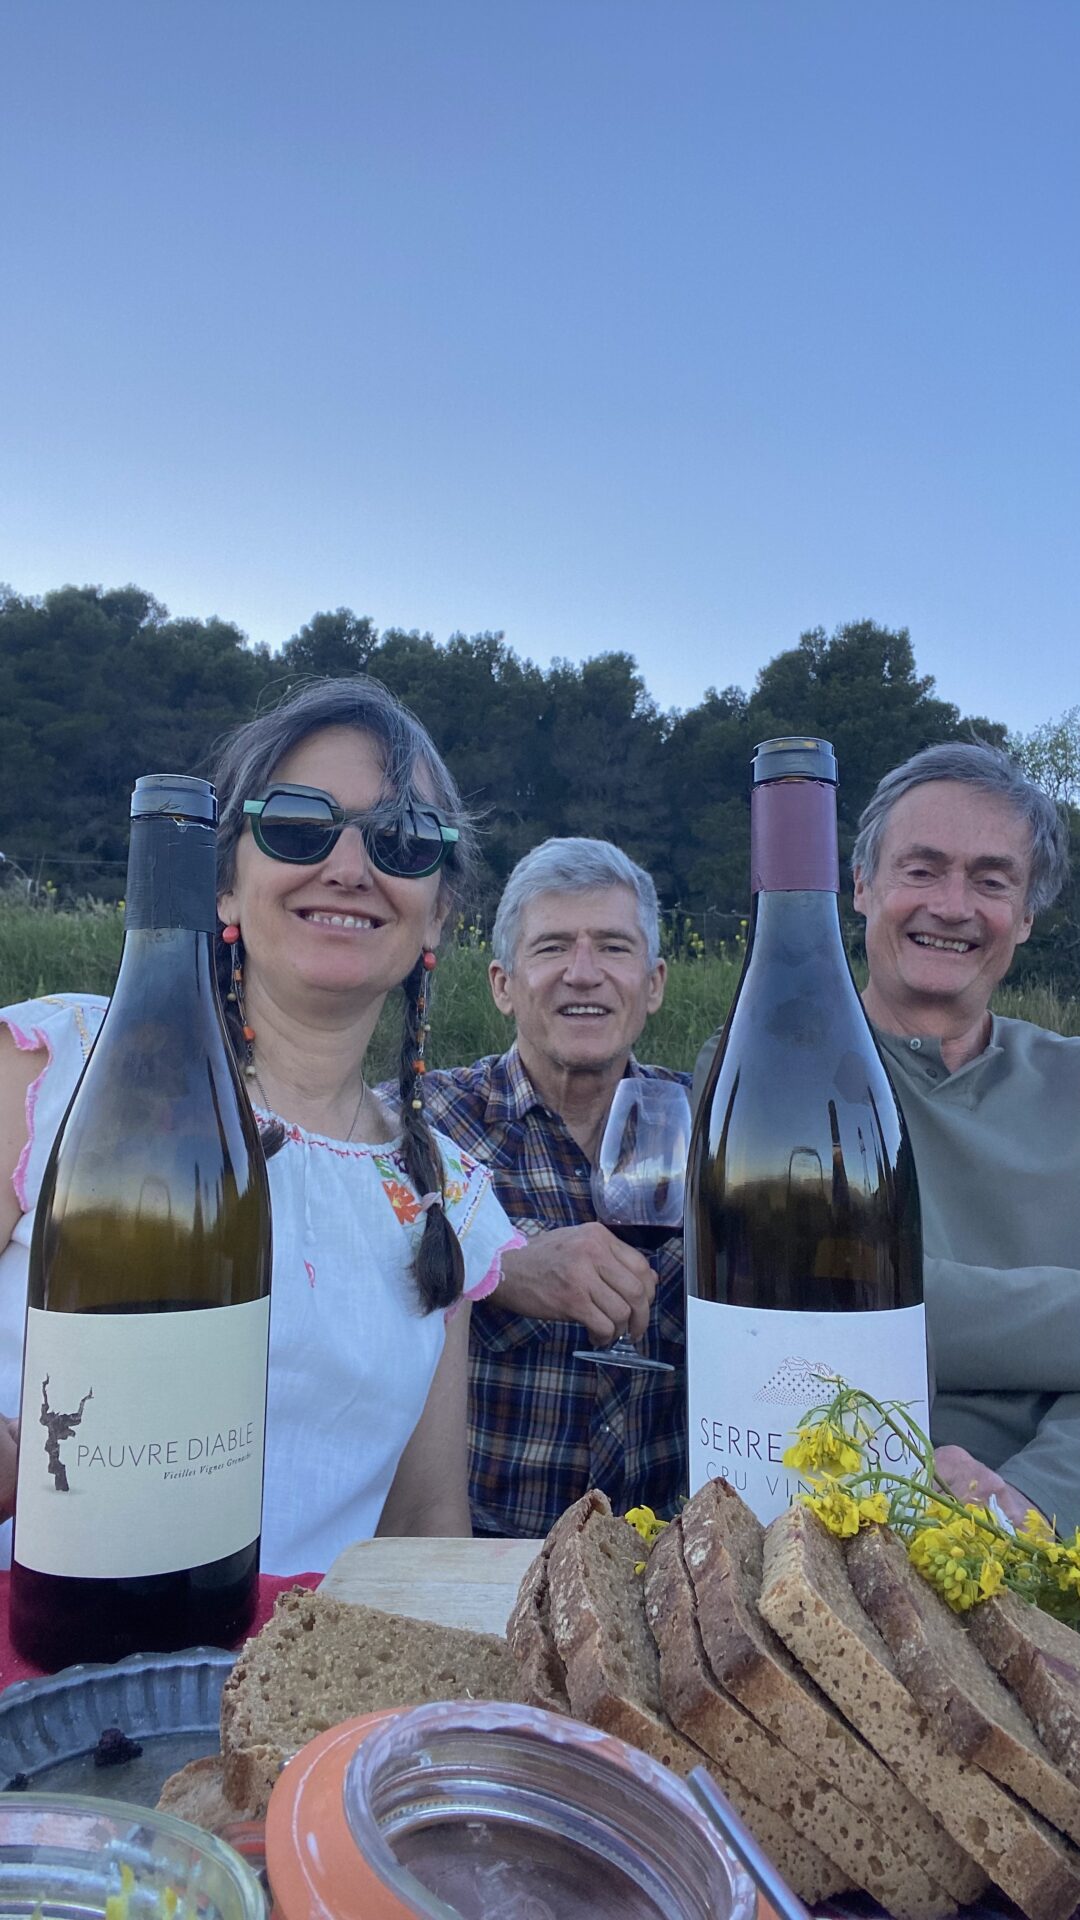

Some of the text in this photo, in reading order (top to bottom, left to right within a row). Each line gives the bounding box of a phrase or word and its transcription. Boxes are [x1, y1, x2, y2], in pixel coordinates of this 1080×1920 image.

[77, 1422, 253, 1467] PAUVRE DIABLE
[701, 1417, 783, 1463] SERRE
[163, 1470, 196, 1481] Vieilles
[199, 1463, 225, 1476] Vignes
